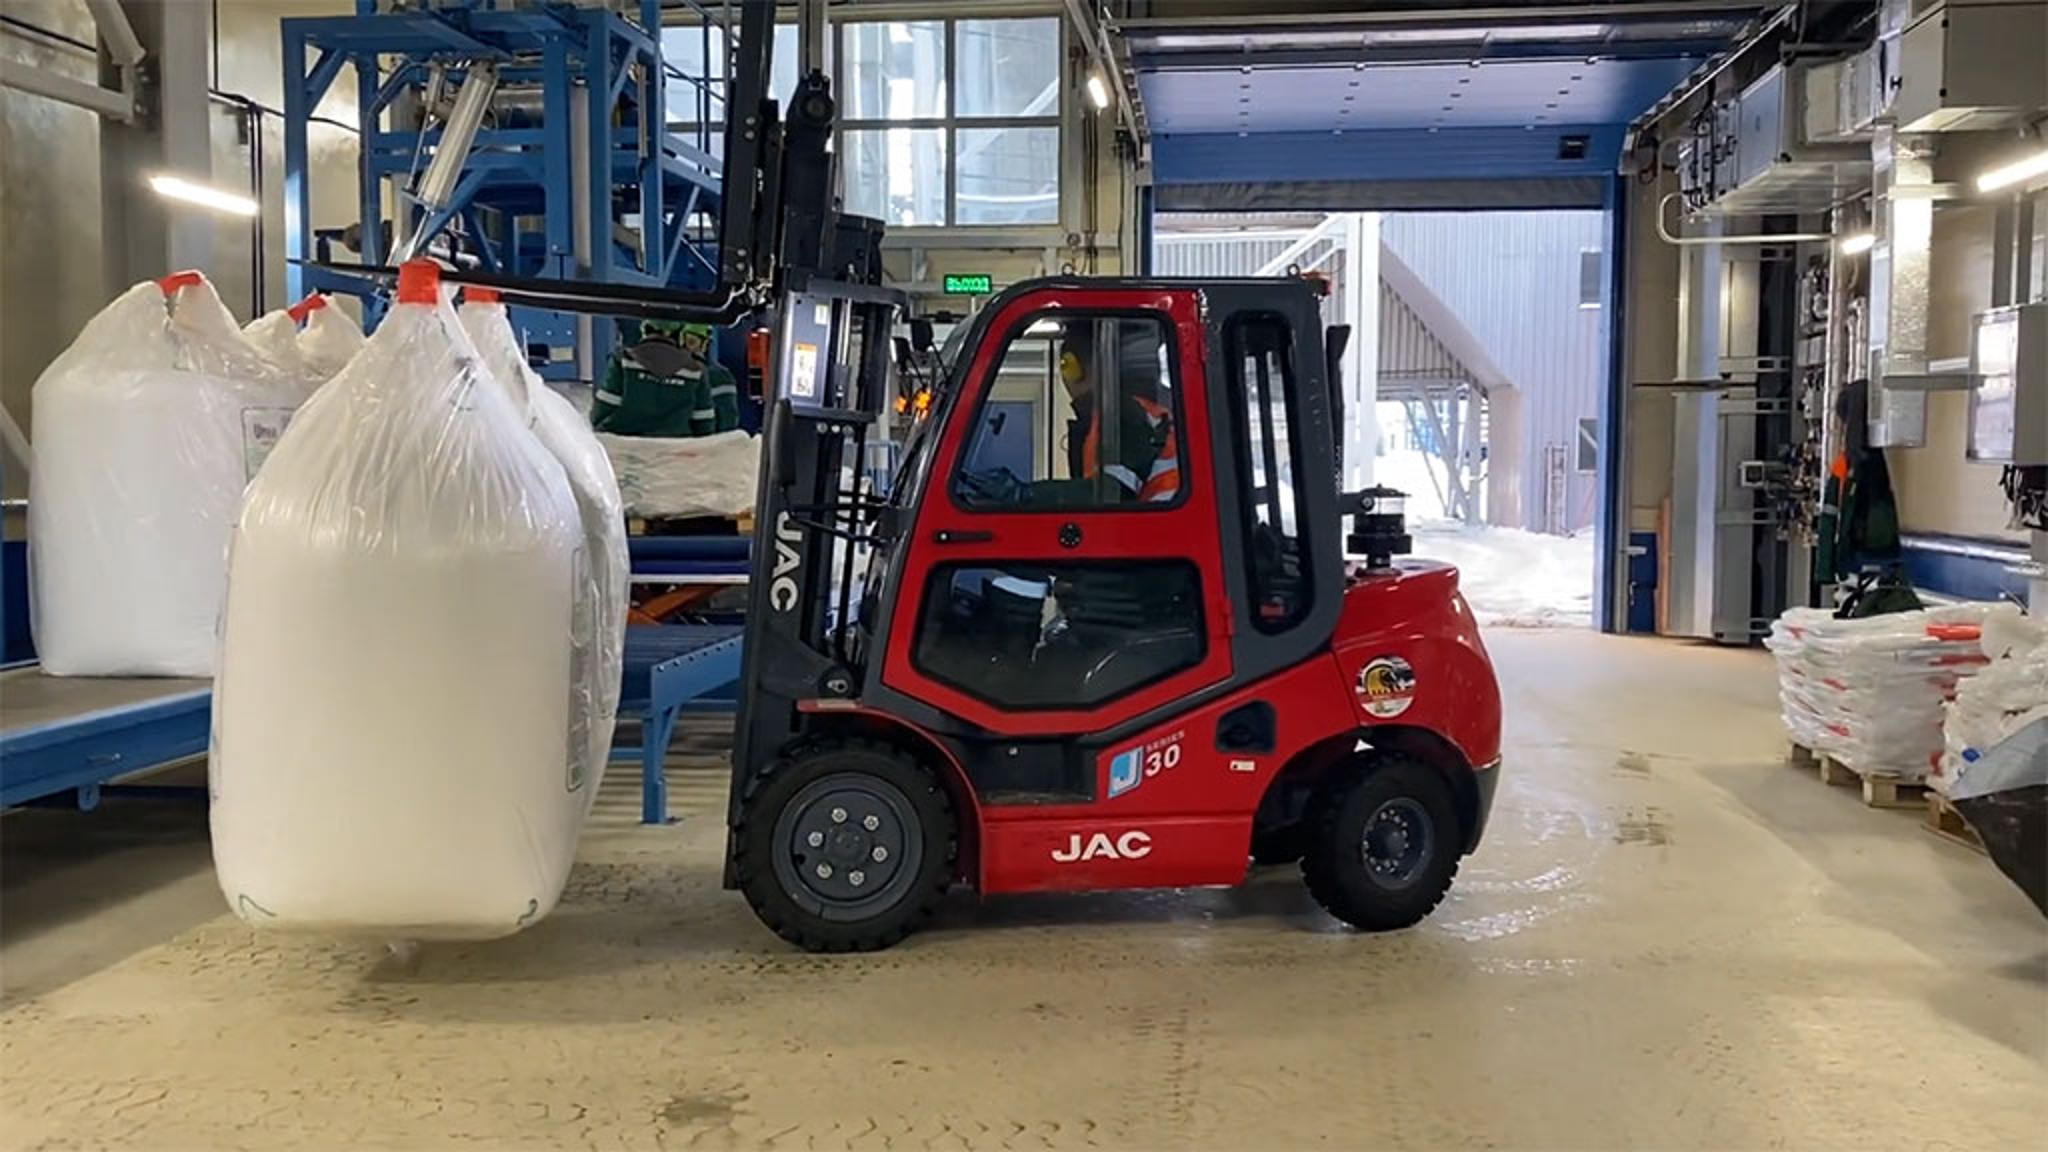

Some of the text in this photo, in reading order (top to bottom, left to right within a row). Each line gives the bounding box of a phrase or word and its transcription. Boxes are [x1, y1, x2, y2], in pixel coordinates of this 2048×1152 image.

[771, 510, 803, 612] JAC
[1146, 730, 1185, 752] SERIES
[1145, 744, 1181, 777] 30
[1051, 830, 1152, 862] JAC
